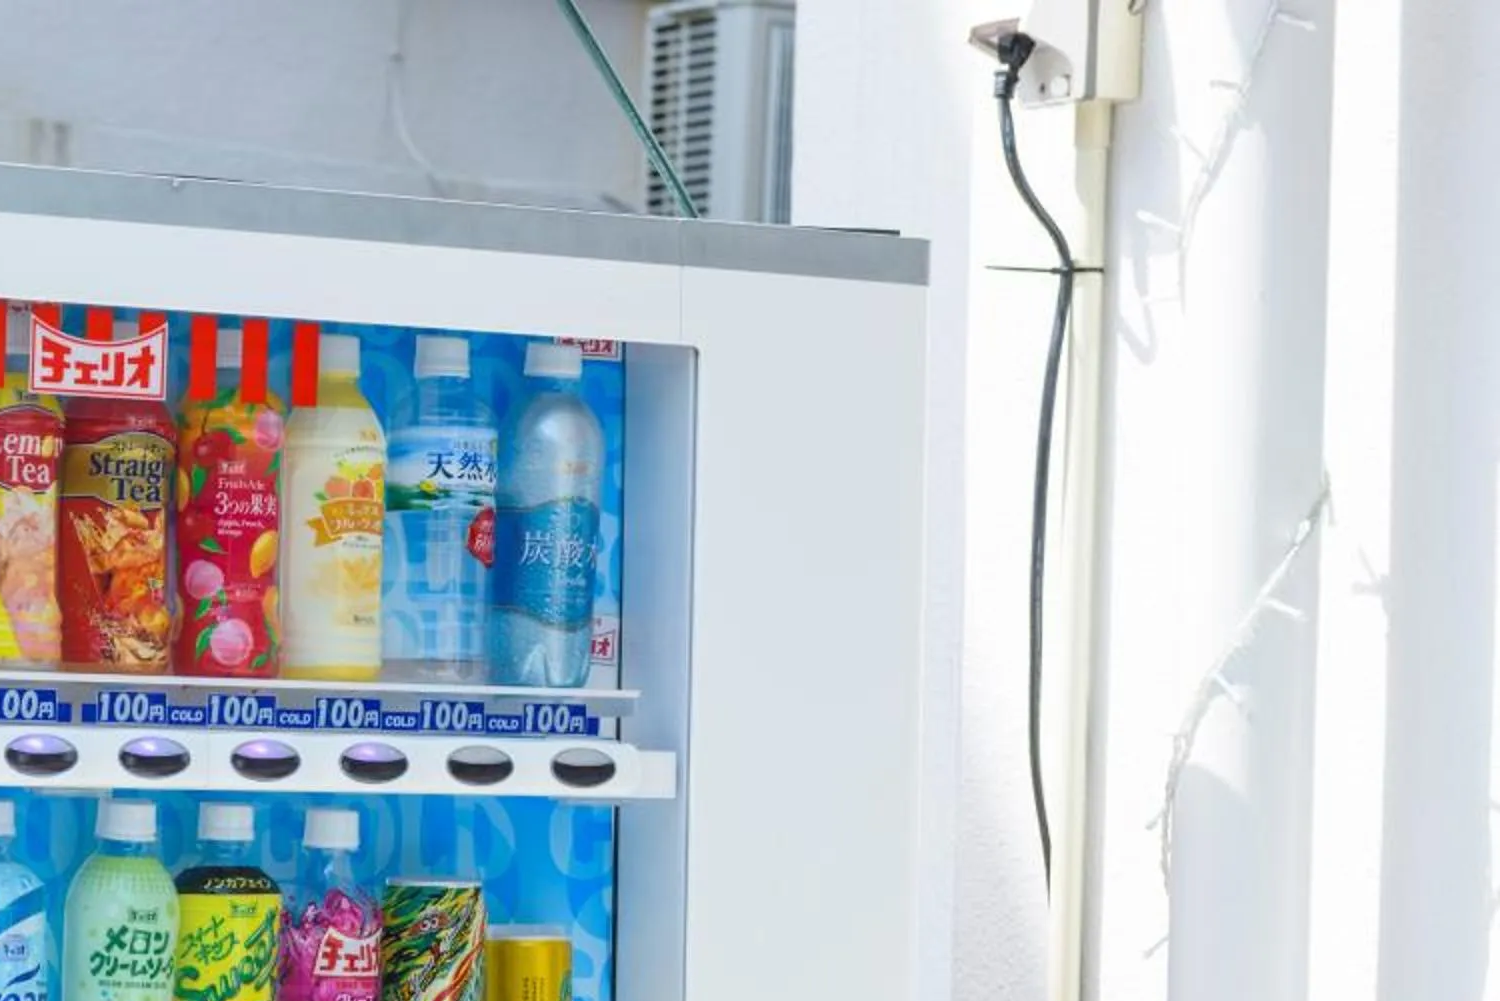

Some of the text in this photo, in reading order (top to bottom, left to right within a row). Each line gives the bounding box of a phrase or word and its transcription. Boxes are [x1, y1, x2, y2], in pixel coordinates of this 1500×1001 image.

[41, 335, 155, 389] チェリオ
[6, 456, 51, 484] Tea
[111, 477, 161, 502] Tea
[214, 491, 277, 516] 3つの果実
[100, 693, 165, 721] 100円
[170, 709, 203, 721] COLD
[209, 695, 274, 725] 100円
[279, 712, 312, 725] COLD
[318, 699, 379, 728] 100円
[422, 701, 483, 730] 100円
[524, 704, 585, 733] 100円
[384, 715, 417, 728] COLD
[488, 718, 520, 730] COLD
[203, 877, 272, 890] ノンカフェイン
[104, 924, 170, 955] メロン
[320, 933, 380, 974] チェリ
